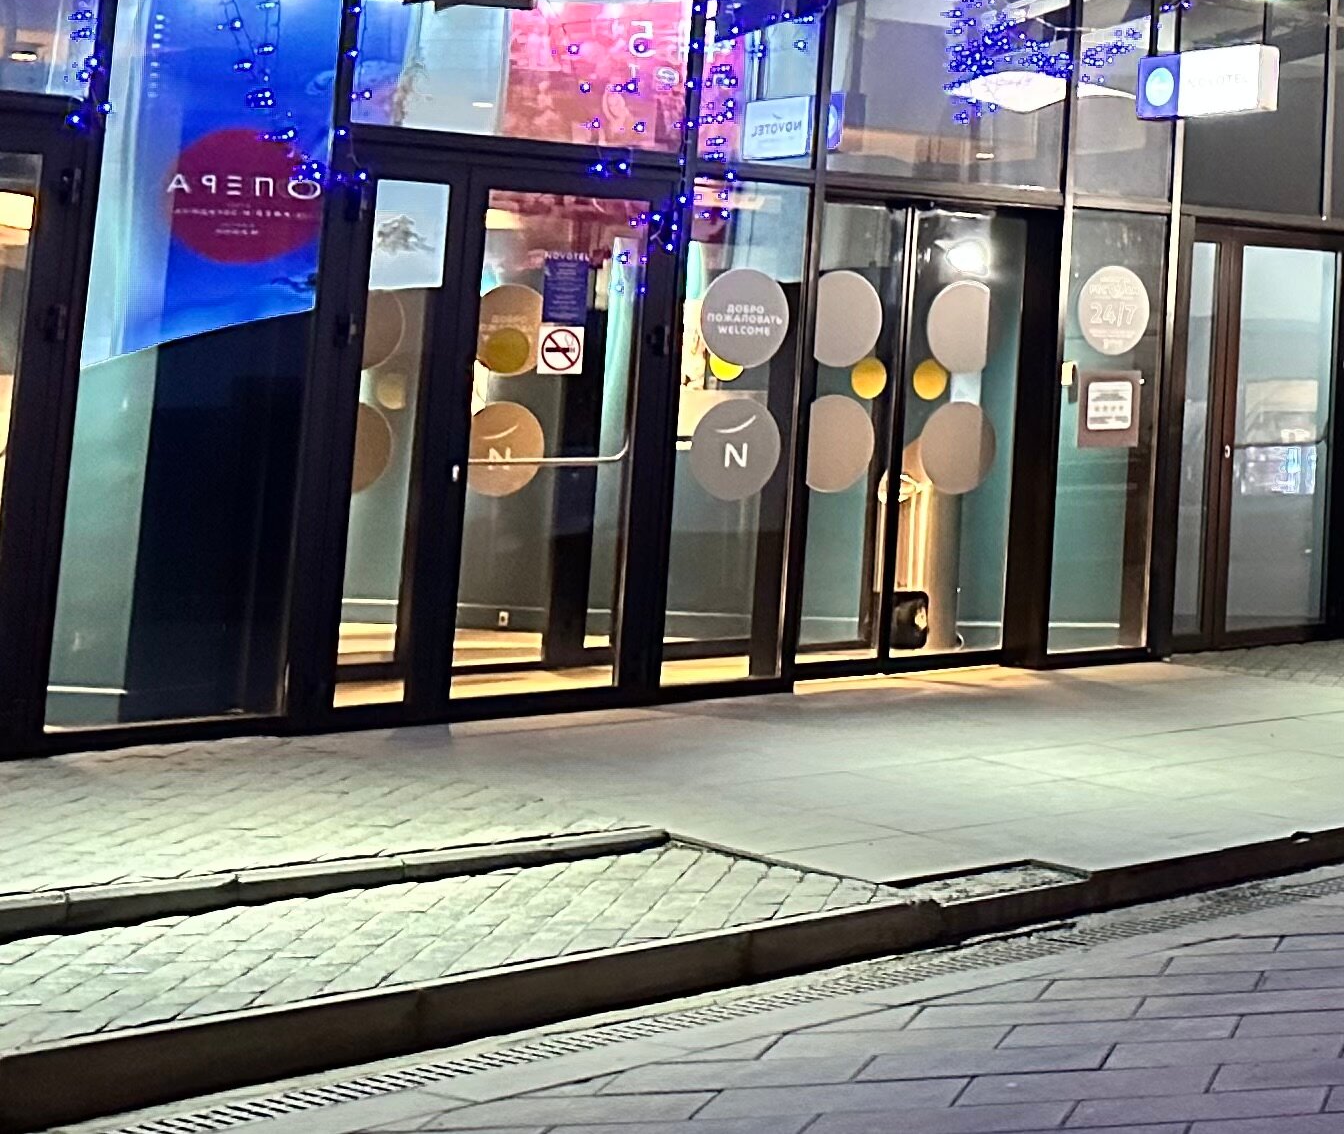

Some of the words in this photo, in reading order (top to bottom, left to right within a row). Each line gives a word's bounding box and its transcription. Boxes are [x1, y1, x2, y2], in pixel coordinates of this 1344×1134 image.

[726, 303, 765, 315] ДОБРО
[1088, 301, 1138, 327] 24/7
[706, 312, 783, 325] ПОЖАЛОВАТЬ
[717, 324, 771, 337] WELCOME
[724, 442, 748, 468] N
